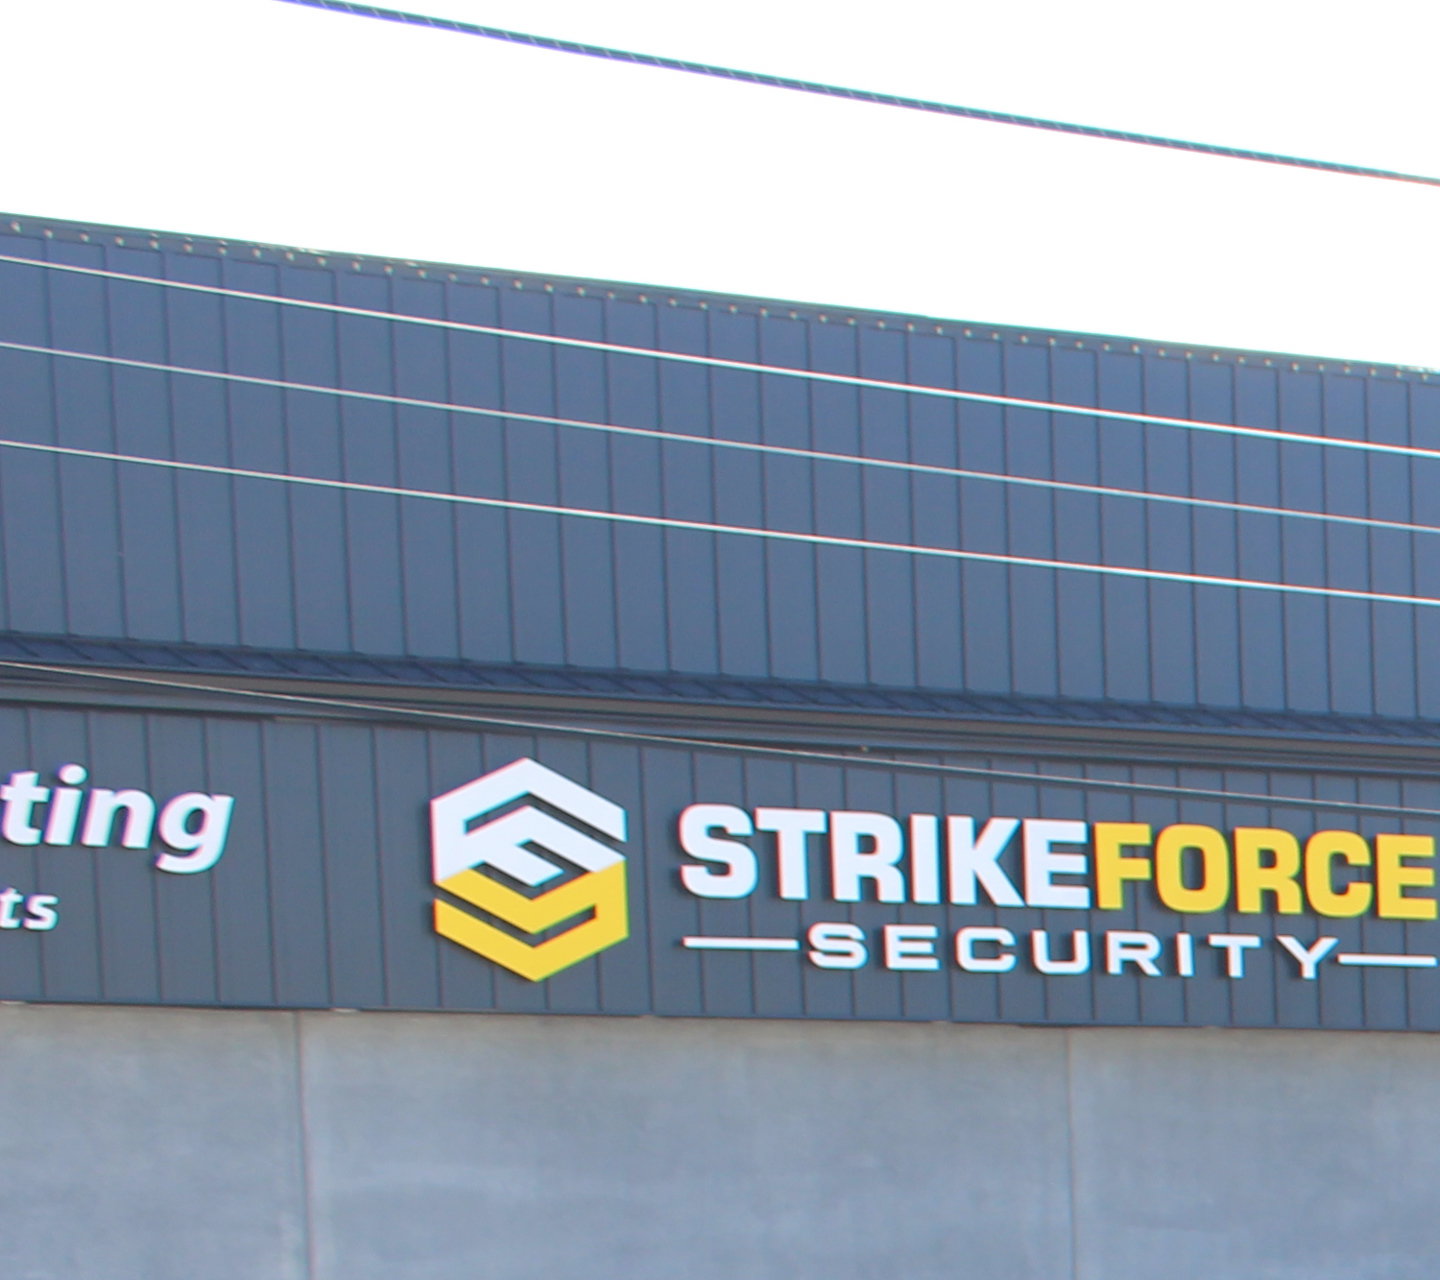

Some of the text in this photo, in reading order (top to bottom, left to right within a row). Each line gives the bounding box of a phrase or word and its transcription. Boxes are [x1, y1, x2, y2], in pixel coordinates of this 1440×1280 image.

[0, 764, 234, 873] ting
[679, 803, 1438, 921] STRIKEFORCE
[0, 888, 57, 930] ts
[808, 922, 1340, 979] SECURITY
